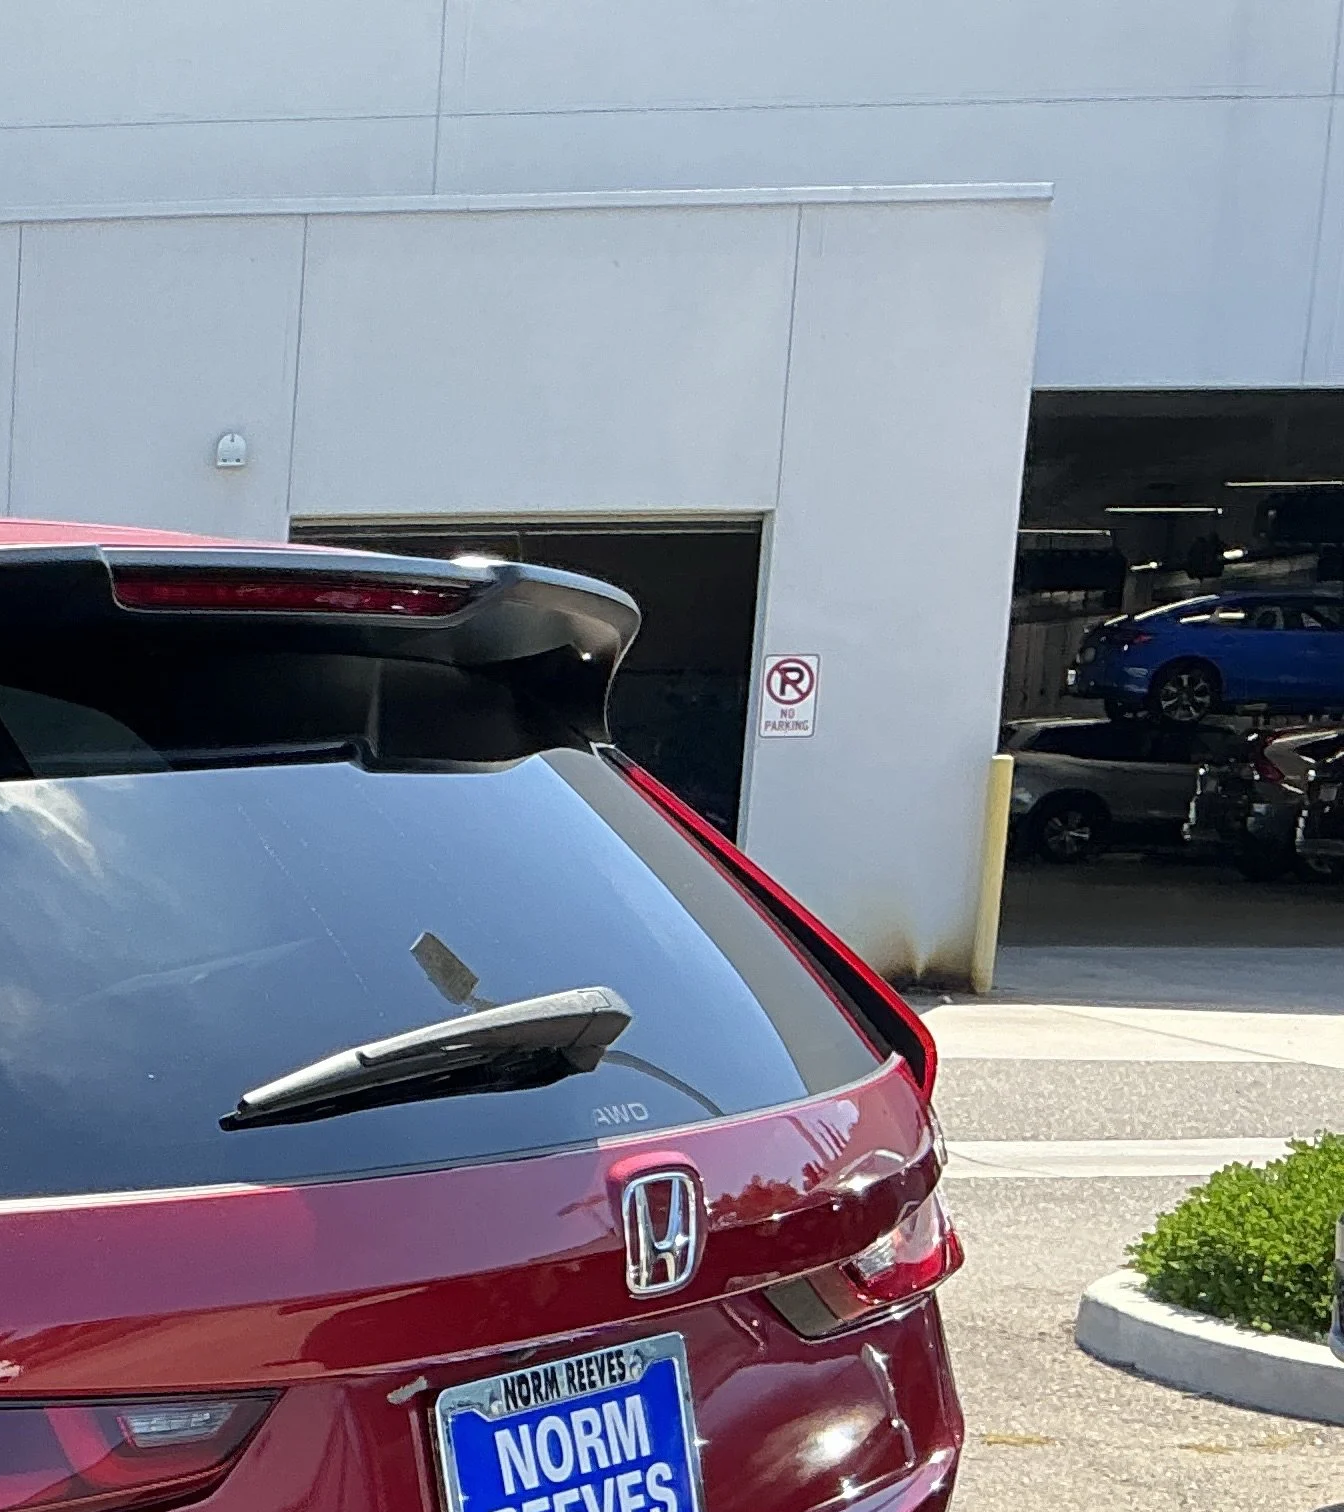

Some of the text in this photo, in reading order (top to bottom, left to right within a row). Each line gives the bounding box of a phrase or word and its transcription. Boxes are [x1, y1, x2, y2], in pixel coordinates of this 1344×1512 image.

[764, 720, 810, 732] PARKING
[780, 708, 796, 719] NO
[594, 1102, 650, 1128] AWD
[500, 1349, 629, 1412] NORM REEVES
[494, 1393, 652, 1496] NORM
